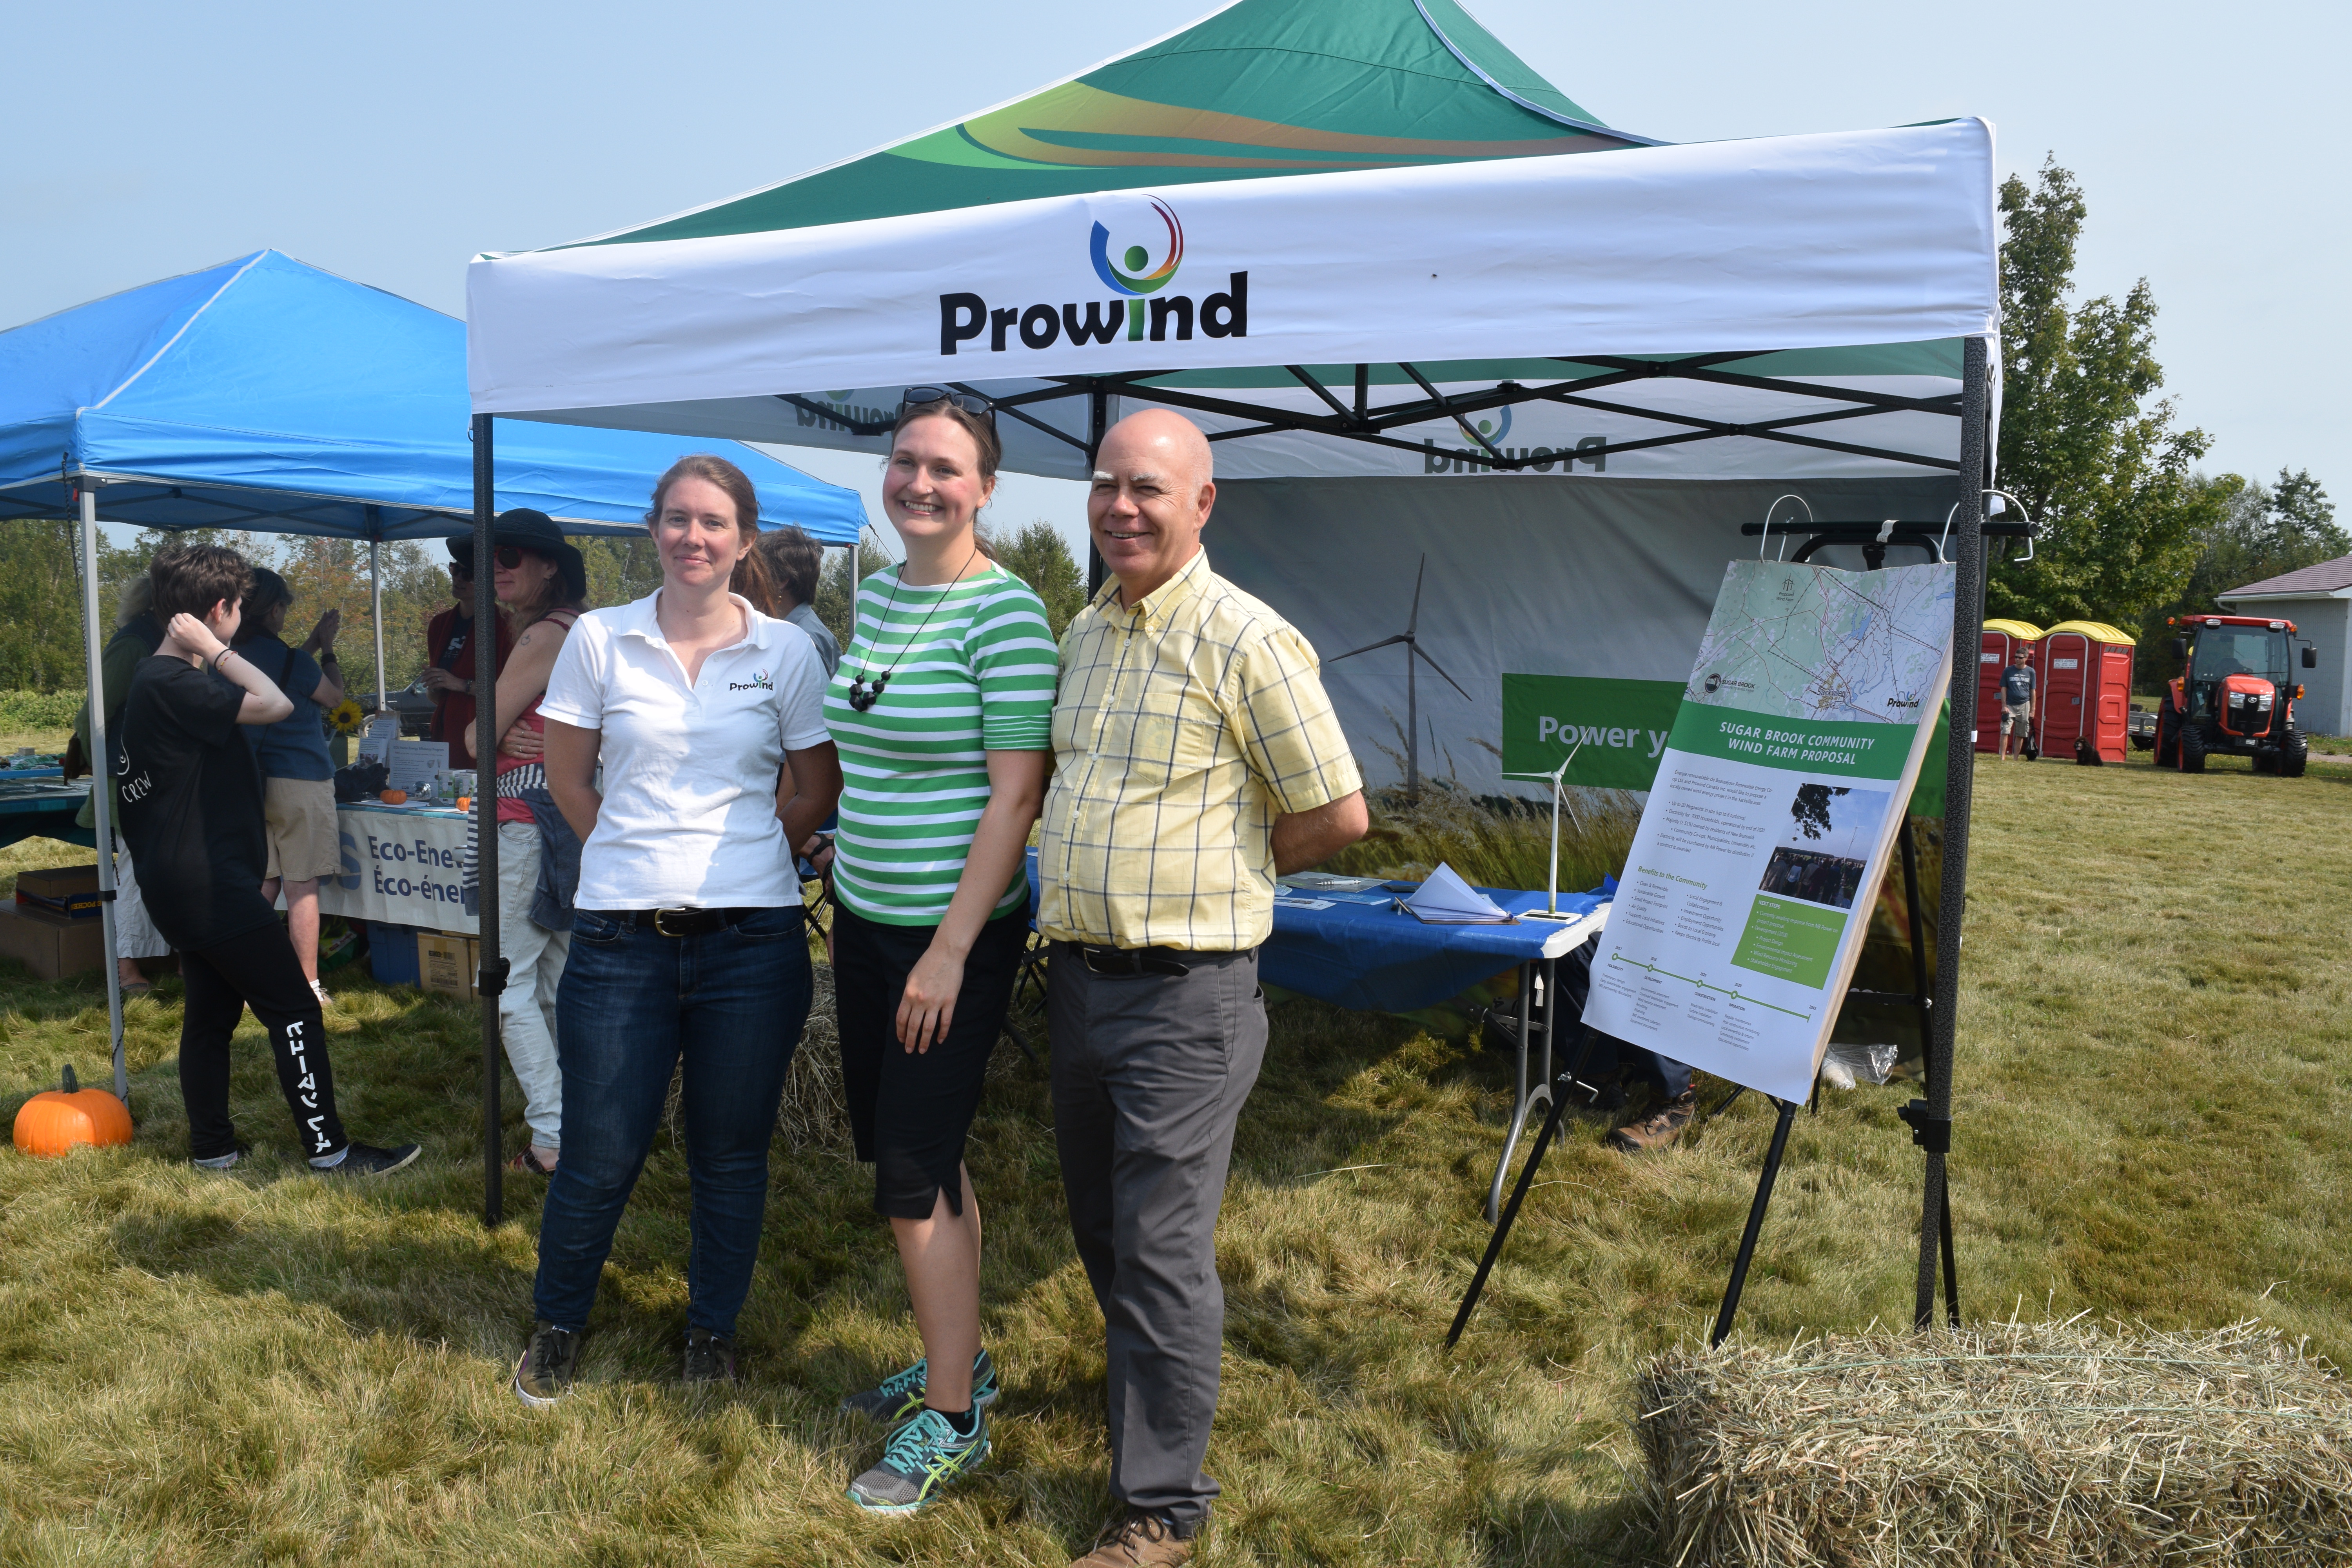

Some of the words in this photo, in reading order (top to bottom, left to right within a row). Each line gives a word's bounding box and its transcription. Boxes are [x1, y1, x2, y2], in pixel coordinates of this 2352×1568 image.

[940, 270, 1248, 355] Prowind
[730, 682, 773, 691] Prowind
[1817, 688, 1843, 697] Sackville
[1887, 698, 1920, 708] Prowind
[1539, 716, 1640, 748] Power
[1648, 730, 1673, 758] y
[1719, 722, 1761, 738] SUGAR
[1765, 730, 1806, 745] BROOK
[1808, 735, 1875, 750] COMMUNITY
[1728, 738, 1762, 753] WIND
[1766, 745, 1798, 759] FARM
[1800, 750, 1855, 764] PROPOSAL
[122, 771, 151, 802] CREW
[368, 835, 463, 869] Eco-Ene
[1638, 866, 1658, 876] Benefits
[1676, 876, 1707, 890] Community
